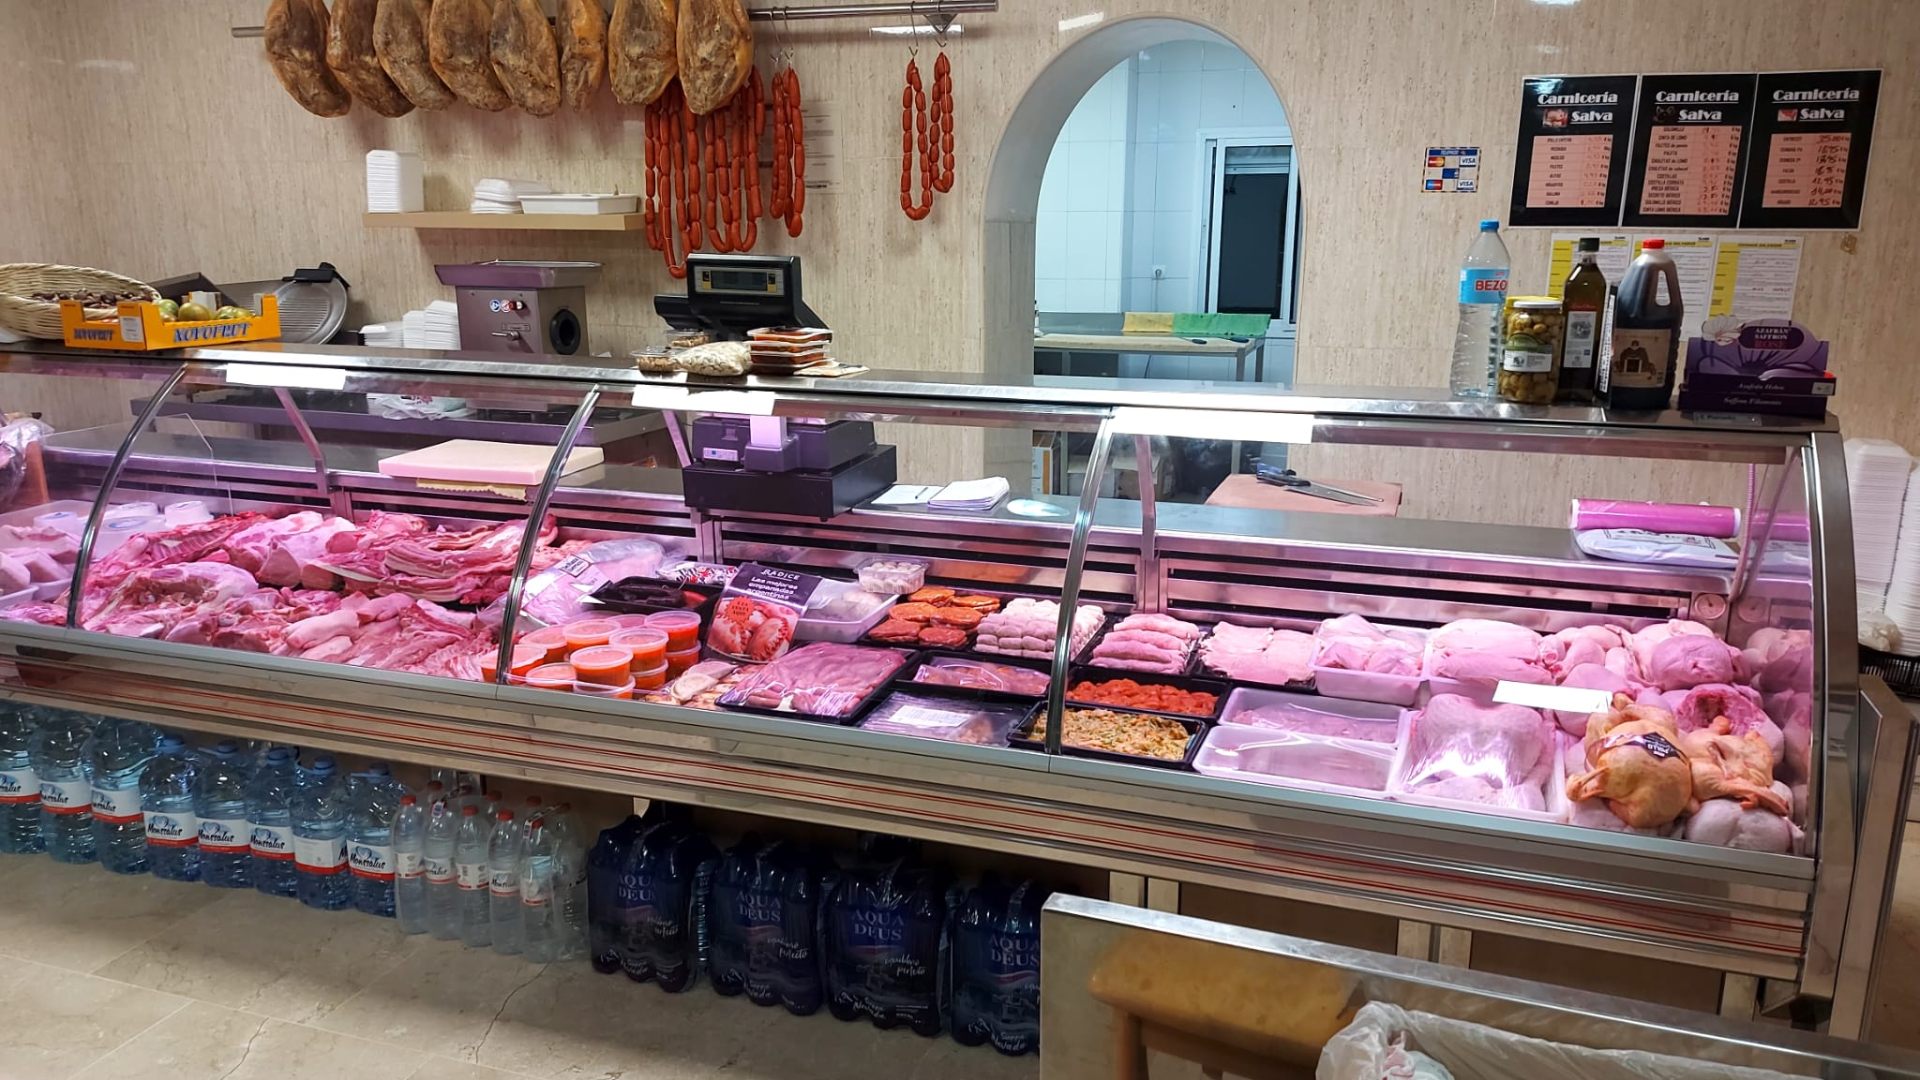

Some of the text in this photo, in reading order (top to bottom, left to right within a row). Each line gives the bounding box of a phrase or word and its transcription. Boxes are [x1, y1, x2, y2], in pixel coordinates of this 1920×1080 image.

[1571, 111, 1613, 121] Salva
[1679, 110, 1722, 120] Salva
[1800, 108, 1845, 119] Salva
[736, 890, 782, 910] AQUA
[739, 903, 782, 922] DEUS
[852, 908, 905, 928] AQUA
[853, 922, 902, 942] DEUS
